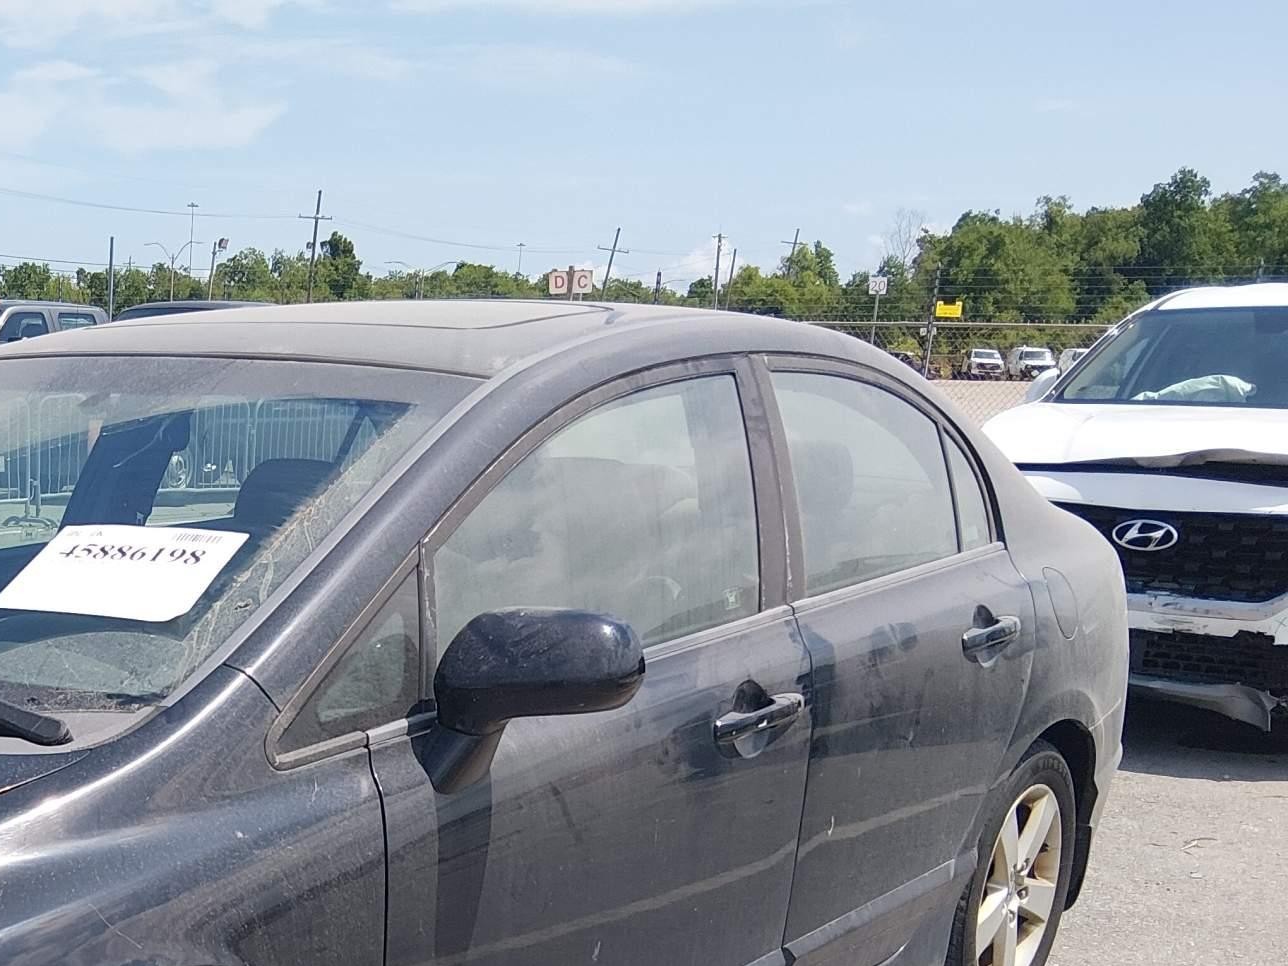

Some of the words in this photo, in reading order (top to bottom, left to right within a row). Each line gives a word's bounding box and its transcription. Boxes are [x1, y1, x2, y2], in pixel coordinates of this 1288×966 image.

[554, 275, 565, 289] D
[577, 274, 588, 289] C
[871, 280, 886, 292] 20
[59, 543, 207, 565] 45886198
